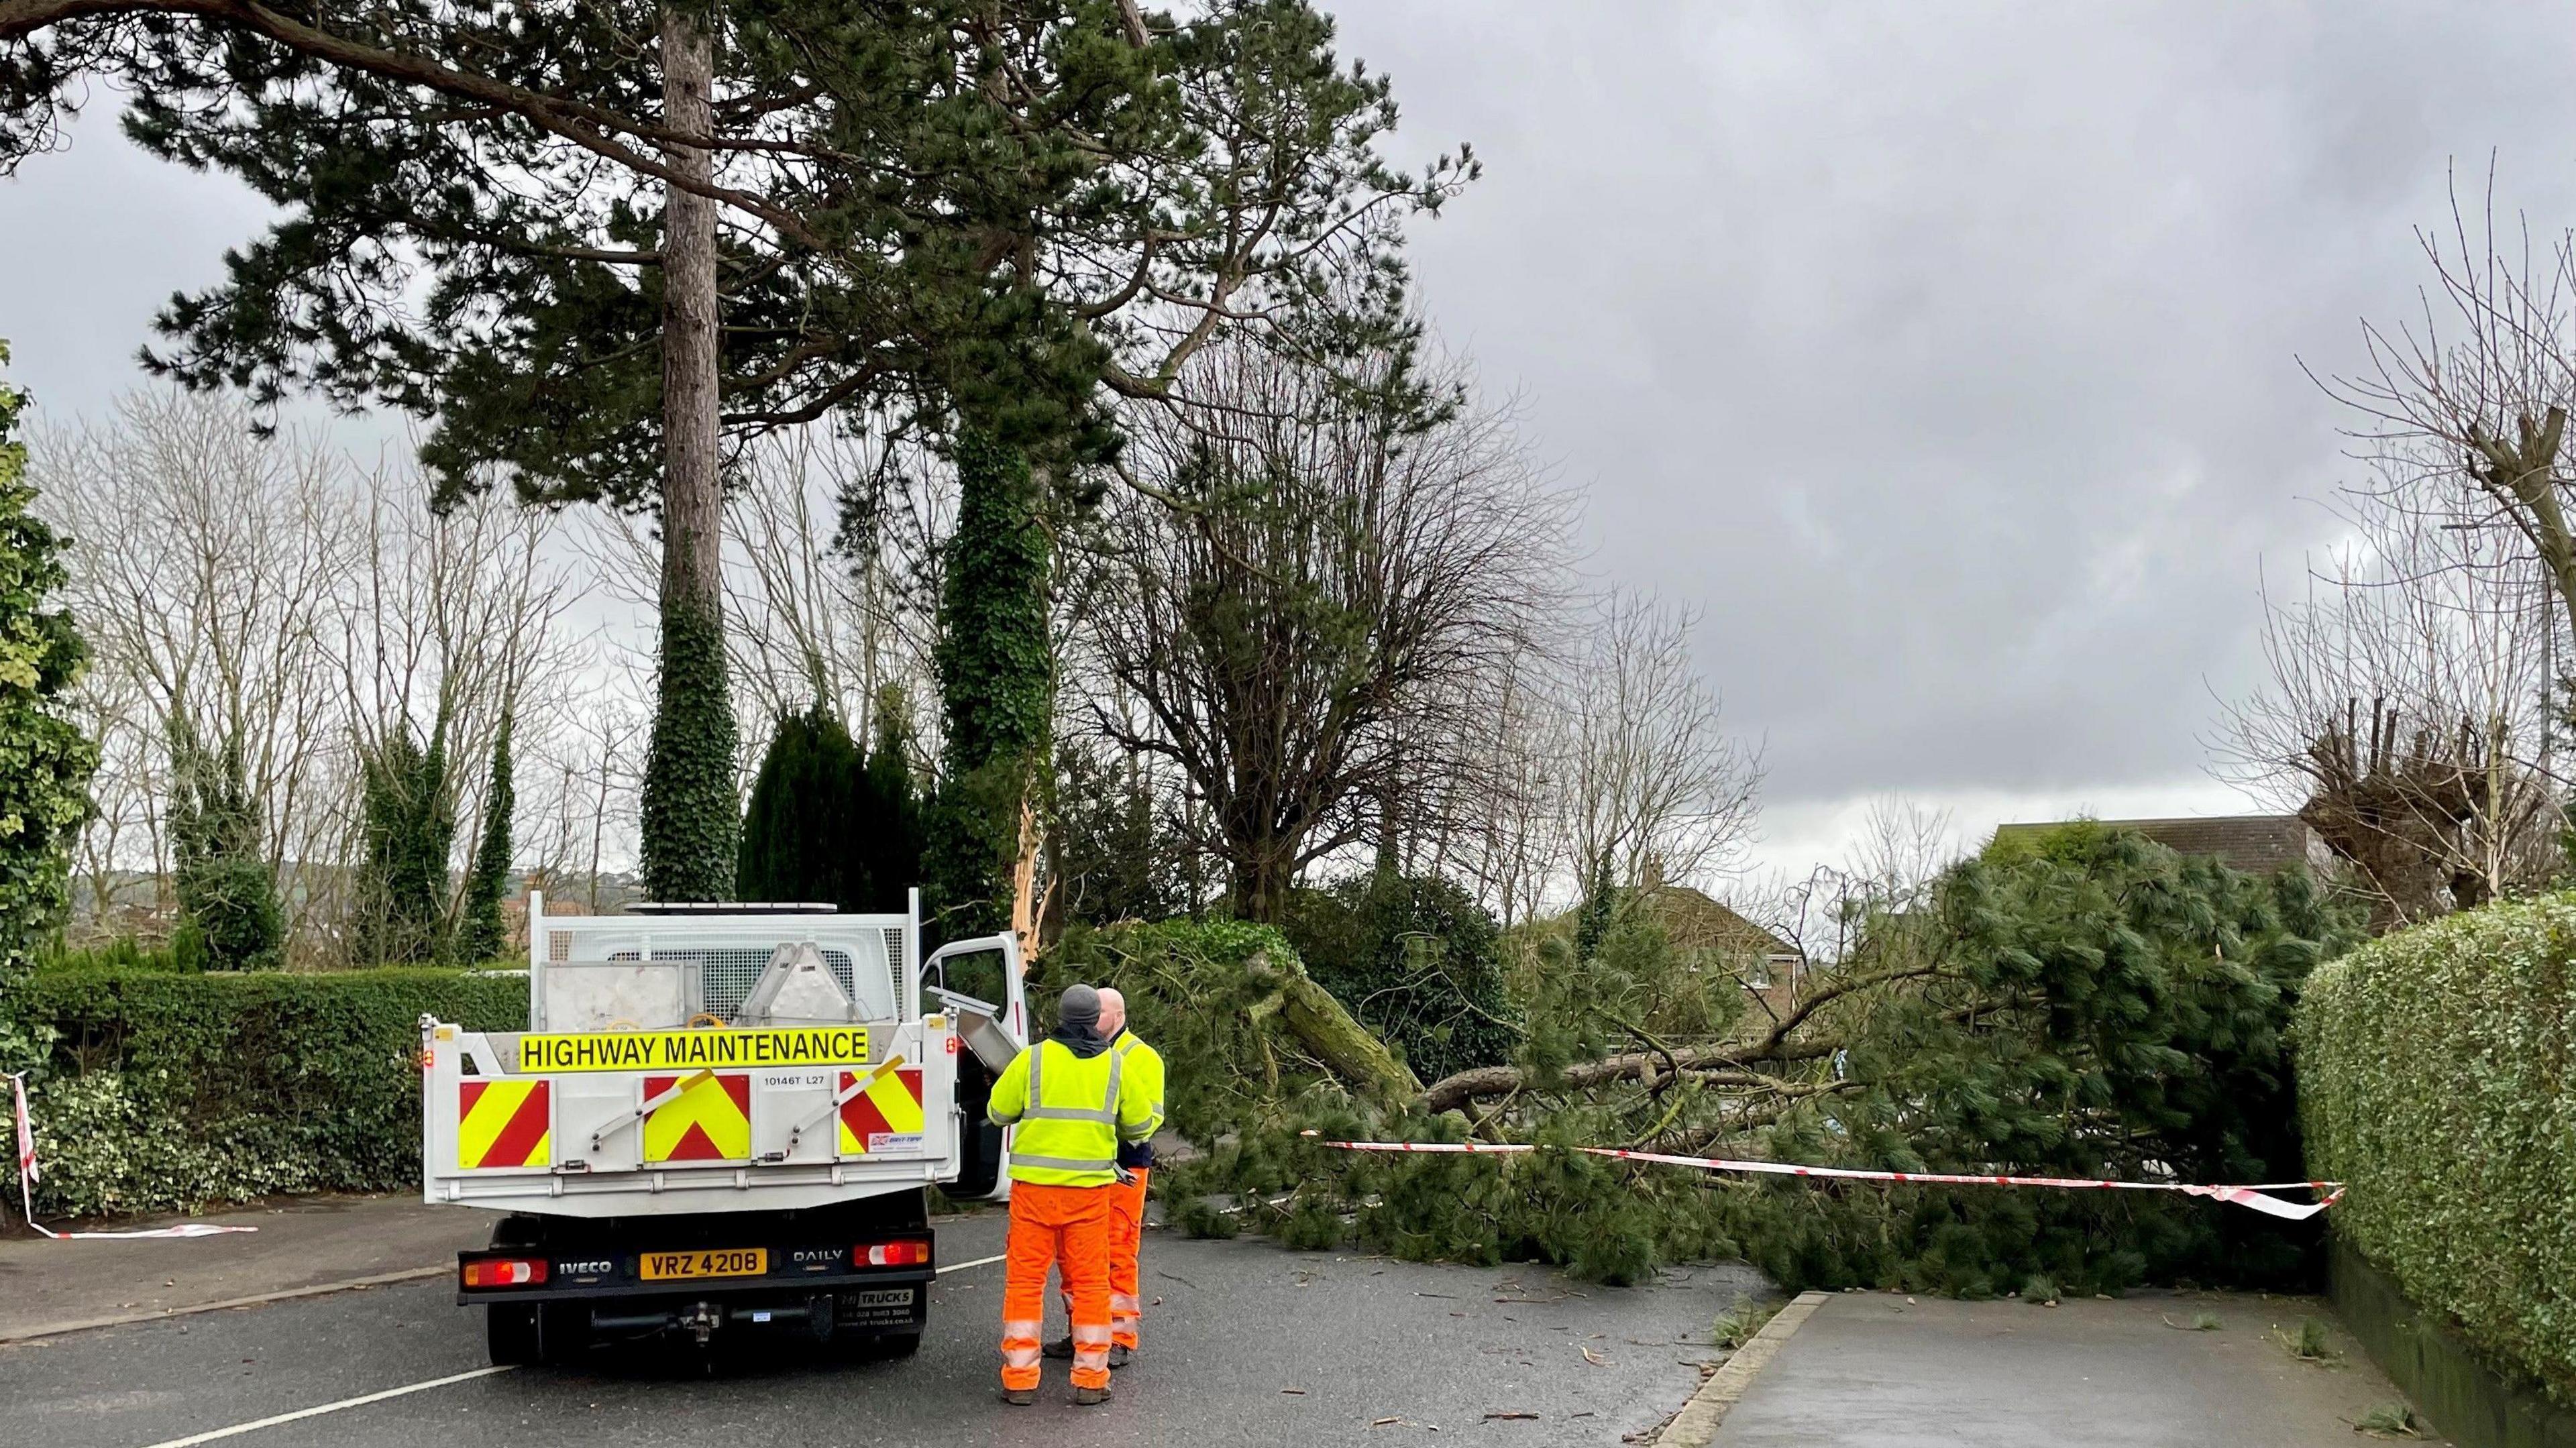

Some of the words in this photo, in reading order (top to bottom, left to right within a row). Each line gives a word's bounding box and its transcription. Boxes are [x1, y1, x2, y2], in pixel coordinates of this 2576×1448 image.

[525, 1037, 656, 1066] HIGHWAY
[665, 1032, 866, 1063] MAINTENANCE
[765, 1076, 800, 1086] 10146T
[806, 1076, 824, 1084] L27
[794, 1249, 843, 1261] DAILY
[559, 1261, 612, 1274] IVECO
[651, 1256, 693, 1276] VRZ
[701, 1252, 757, 1273] 4208
[861, 1292, 910, 1304] TRUCKS
